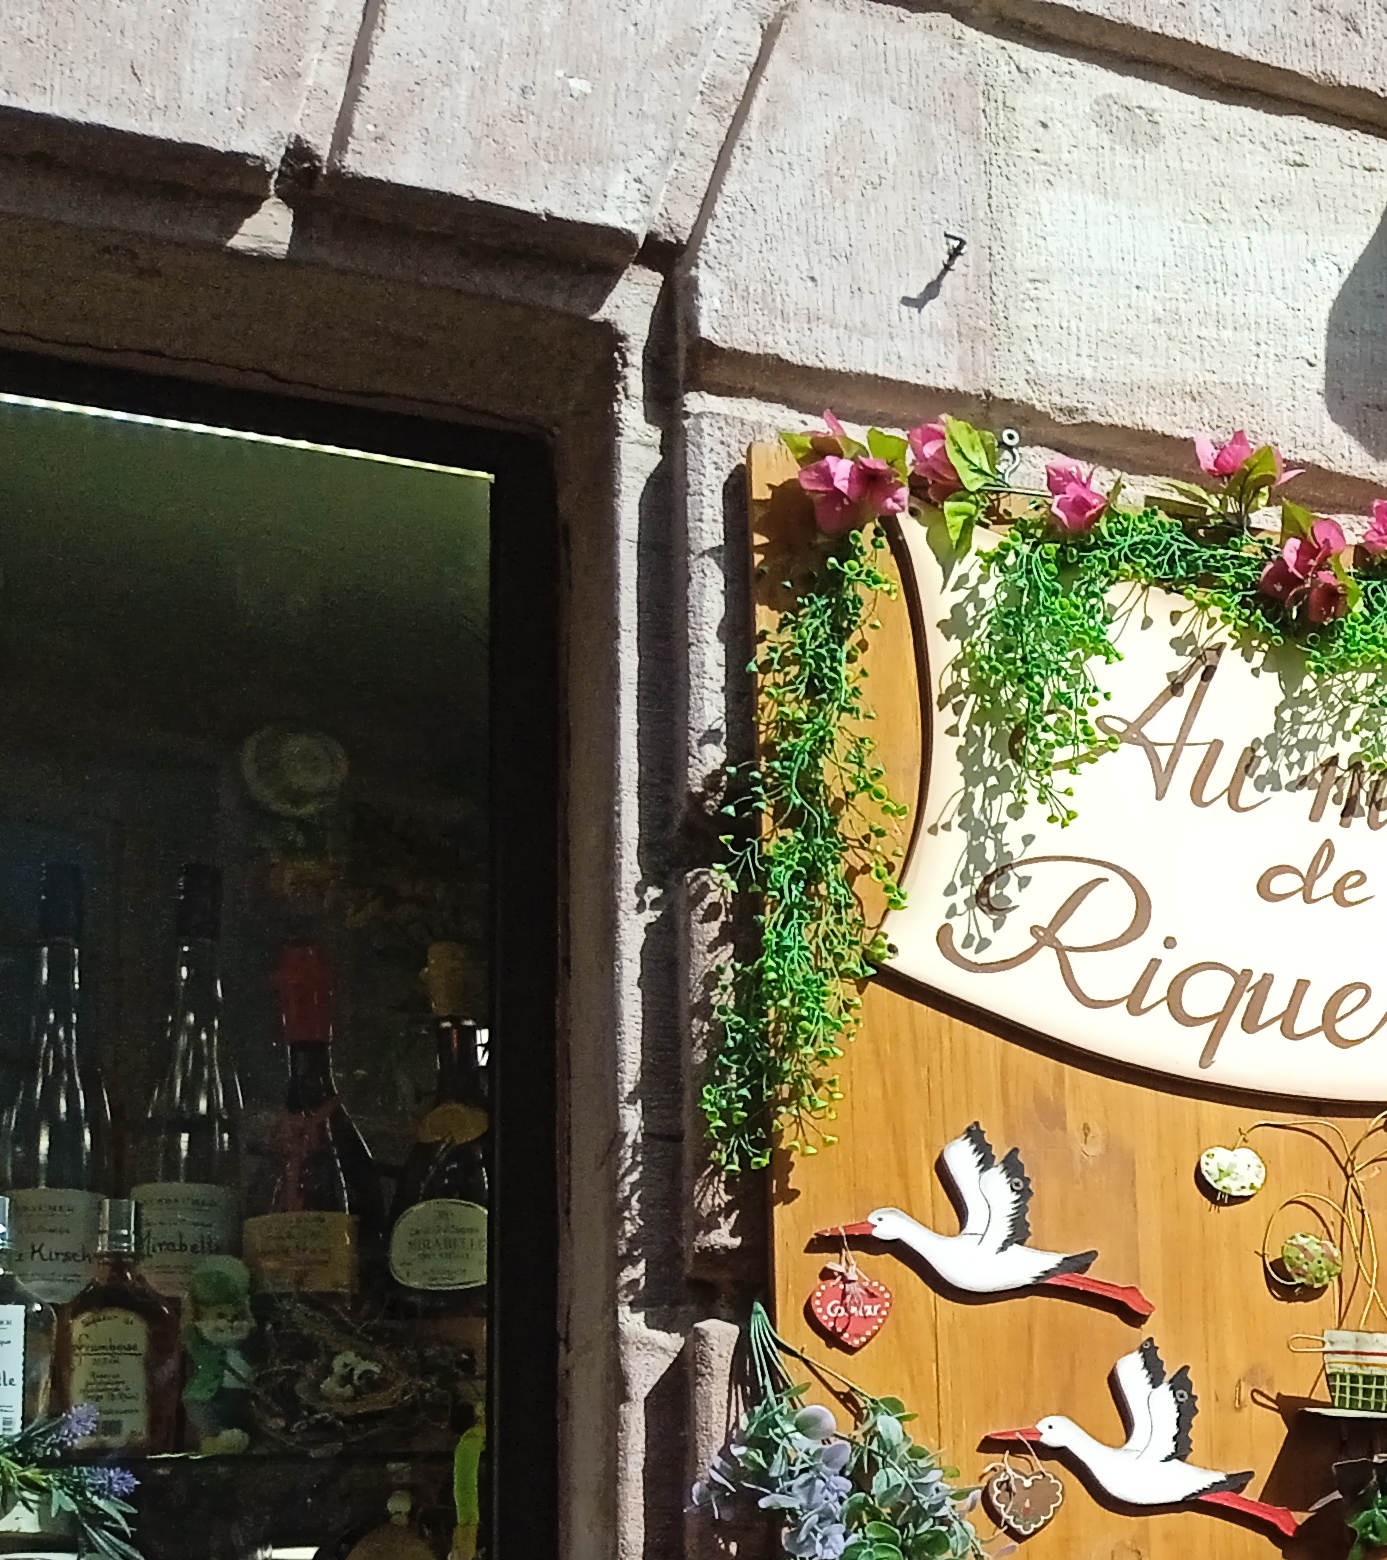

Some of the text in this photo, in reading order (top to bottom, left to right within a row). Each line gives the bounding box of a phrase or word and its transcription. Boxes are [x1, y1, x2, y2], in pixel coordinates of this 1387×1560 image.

[1008, 642, 1272, 814] Au
[1256, 837, 1376, 908] de
[827, 1299, 882, 1318] Comar
